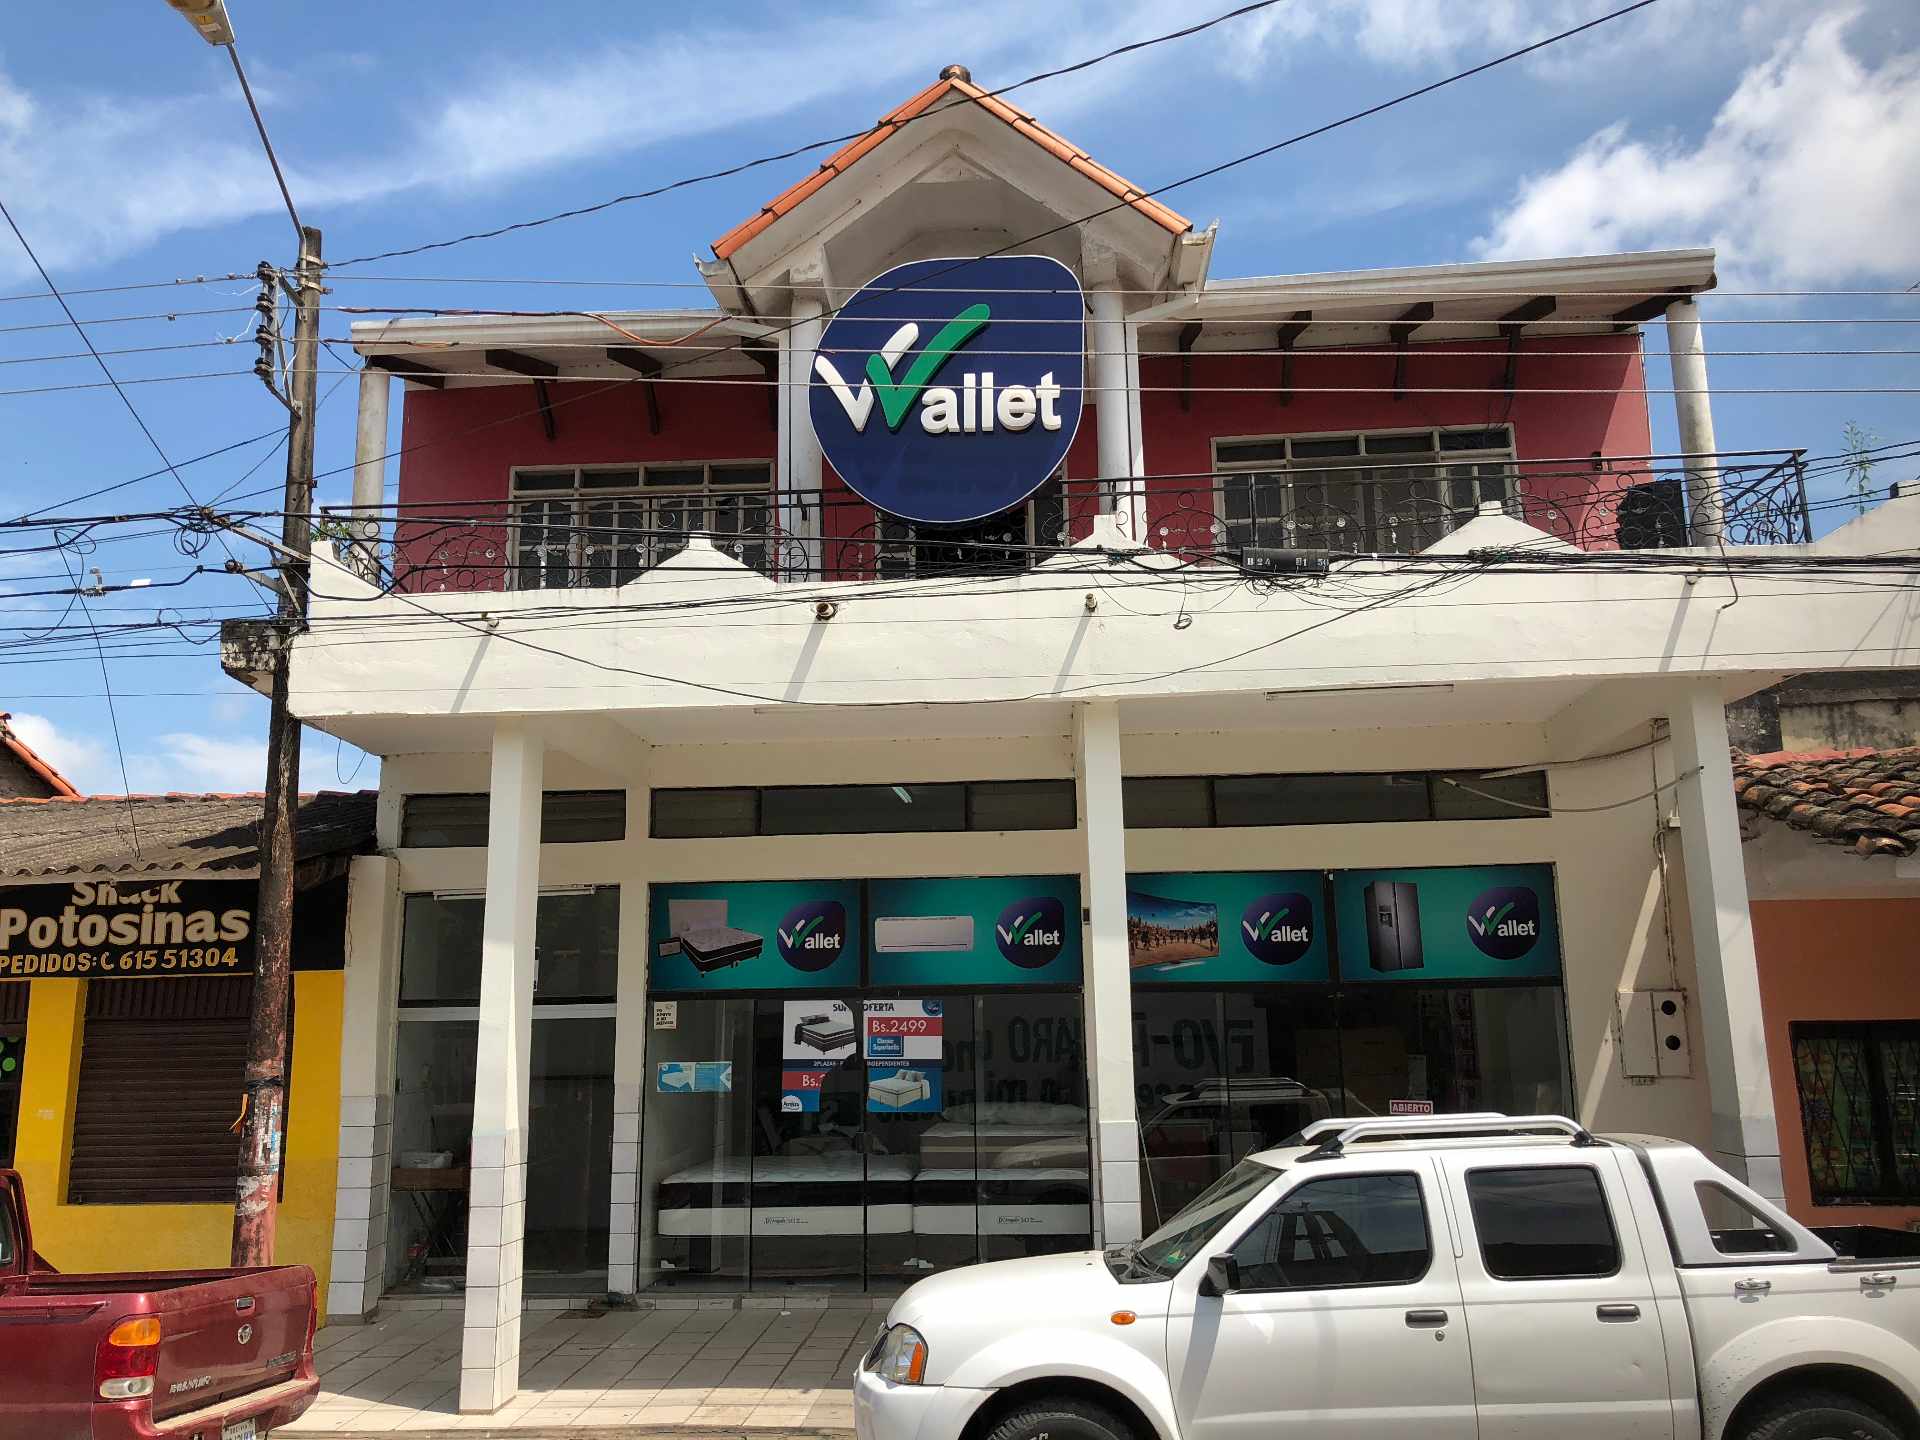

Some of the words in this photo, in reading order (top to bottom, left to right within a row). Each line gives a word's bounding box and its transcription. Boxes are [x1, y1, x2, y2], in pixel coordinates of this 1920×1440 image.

[814, 304, 1062, 433] Wallet
[72, 880, 182, 905] Snck
[0, 903, 251, 950] Potosinas
[778, 916, 841, 949] Wallet
[997, 911, 1060, 947] Wallet
[1243, 908, 1309, 943] Wallet
[1468, 902, 1536, 938] Wallet
[872, 1019, 927, 1033] Bs.2499
[1392, 1103, 1431, 1113] ABIERTO
